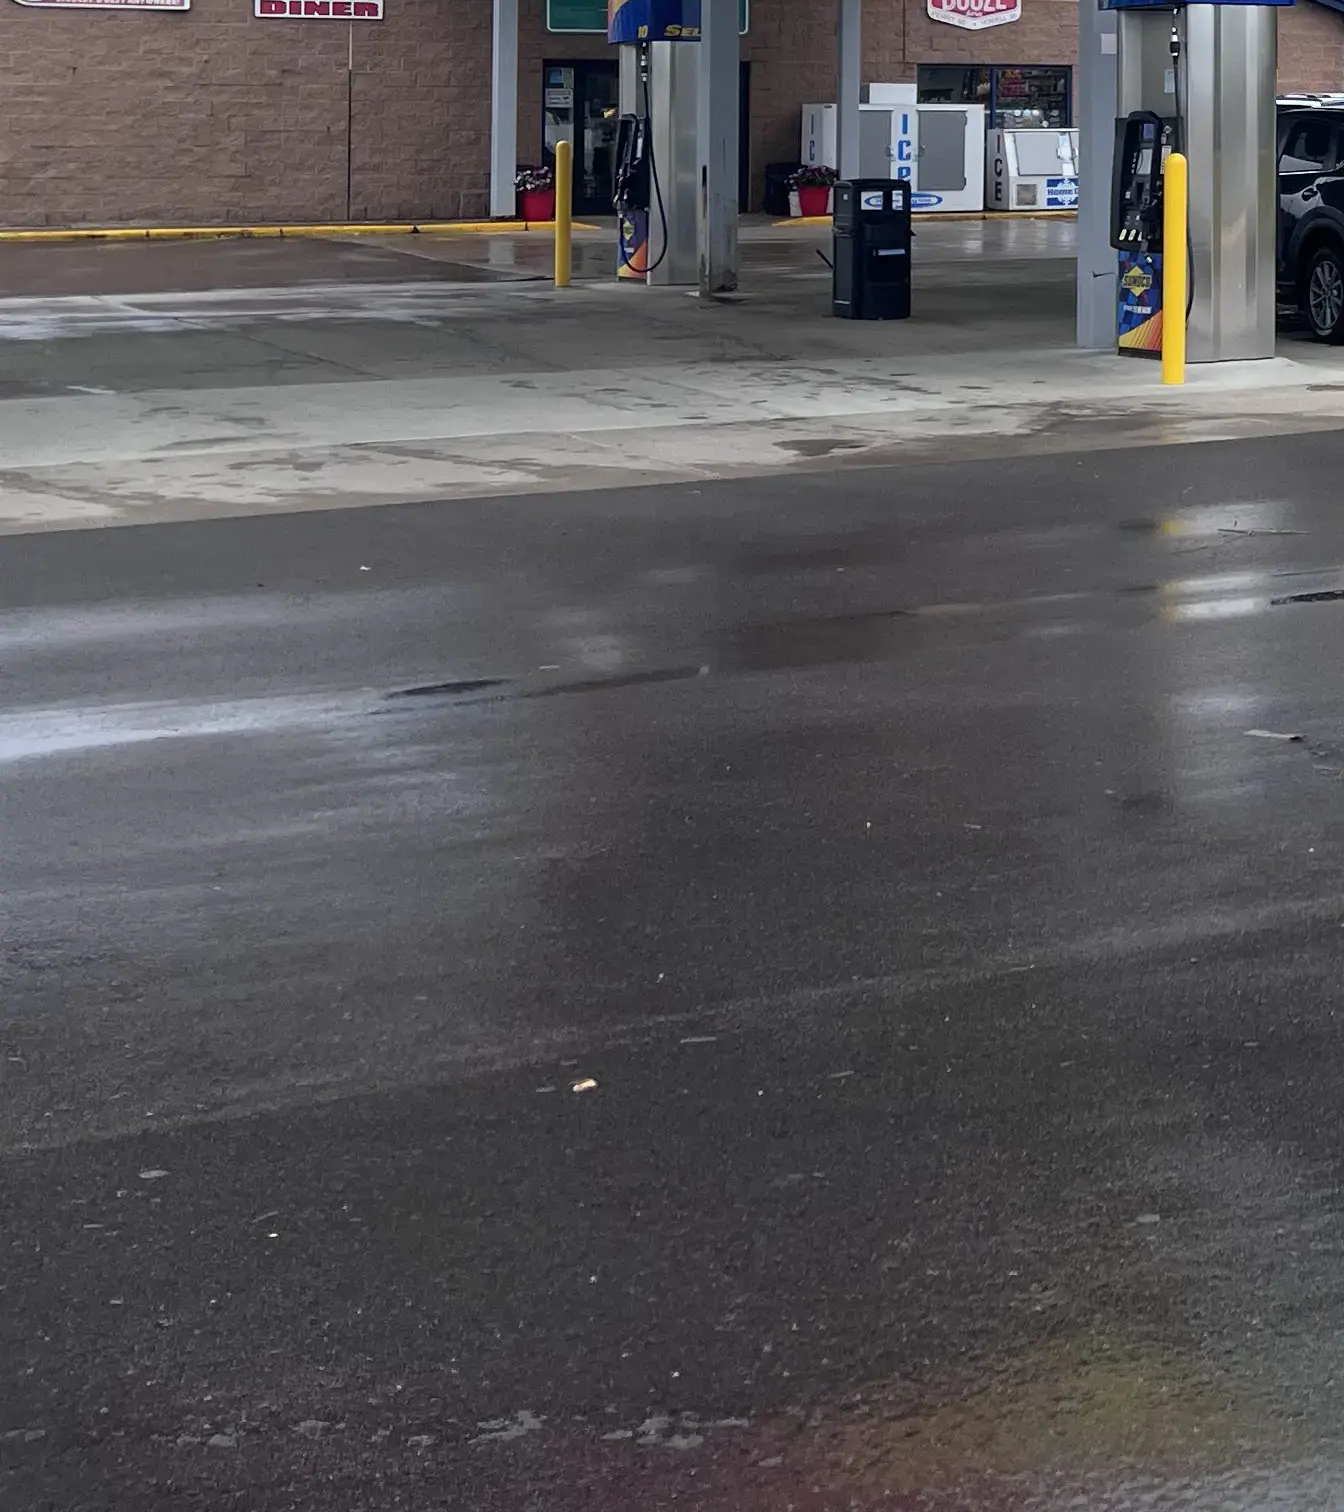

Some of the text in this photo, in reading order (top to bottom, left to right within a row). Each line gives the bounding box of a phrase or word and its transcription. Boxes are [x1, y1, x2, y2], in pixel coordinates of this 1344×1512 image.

[260, 0, 379, 17] DINER
[637, 25, 649, 39] 10
[664, 24, 702, 37] SEL
[994, 133, 1003, 202] ICE
